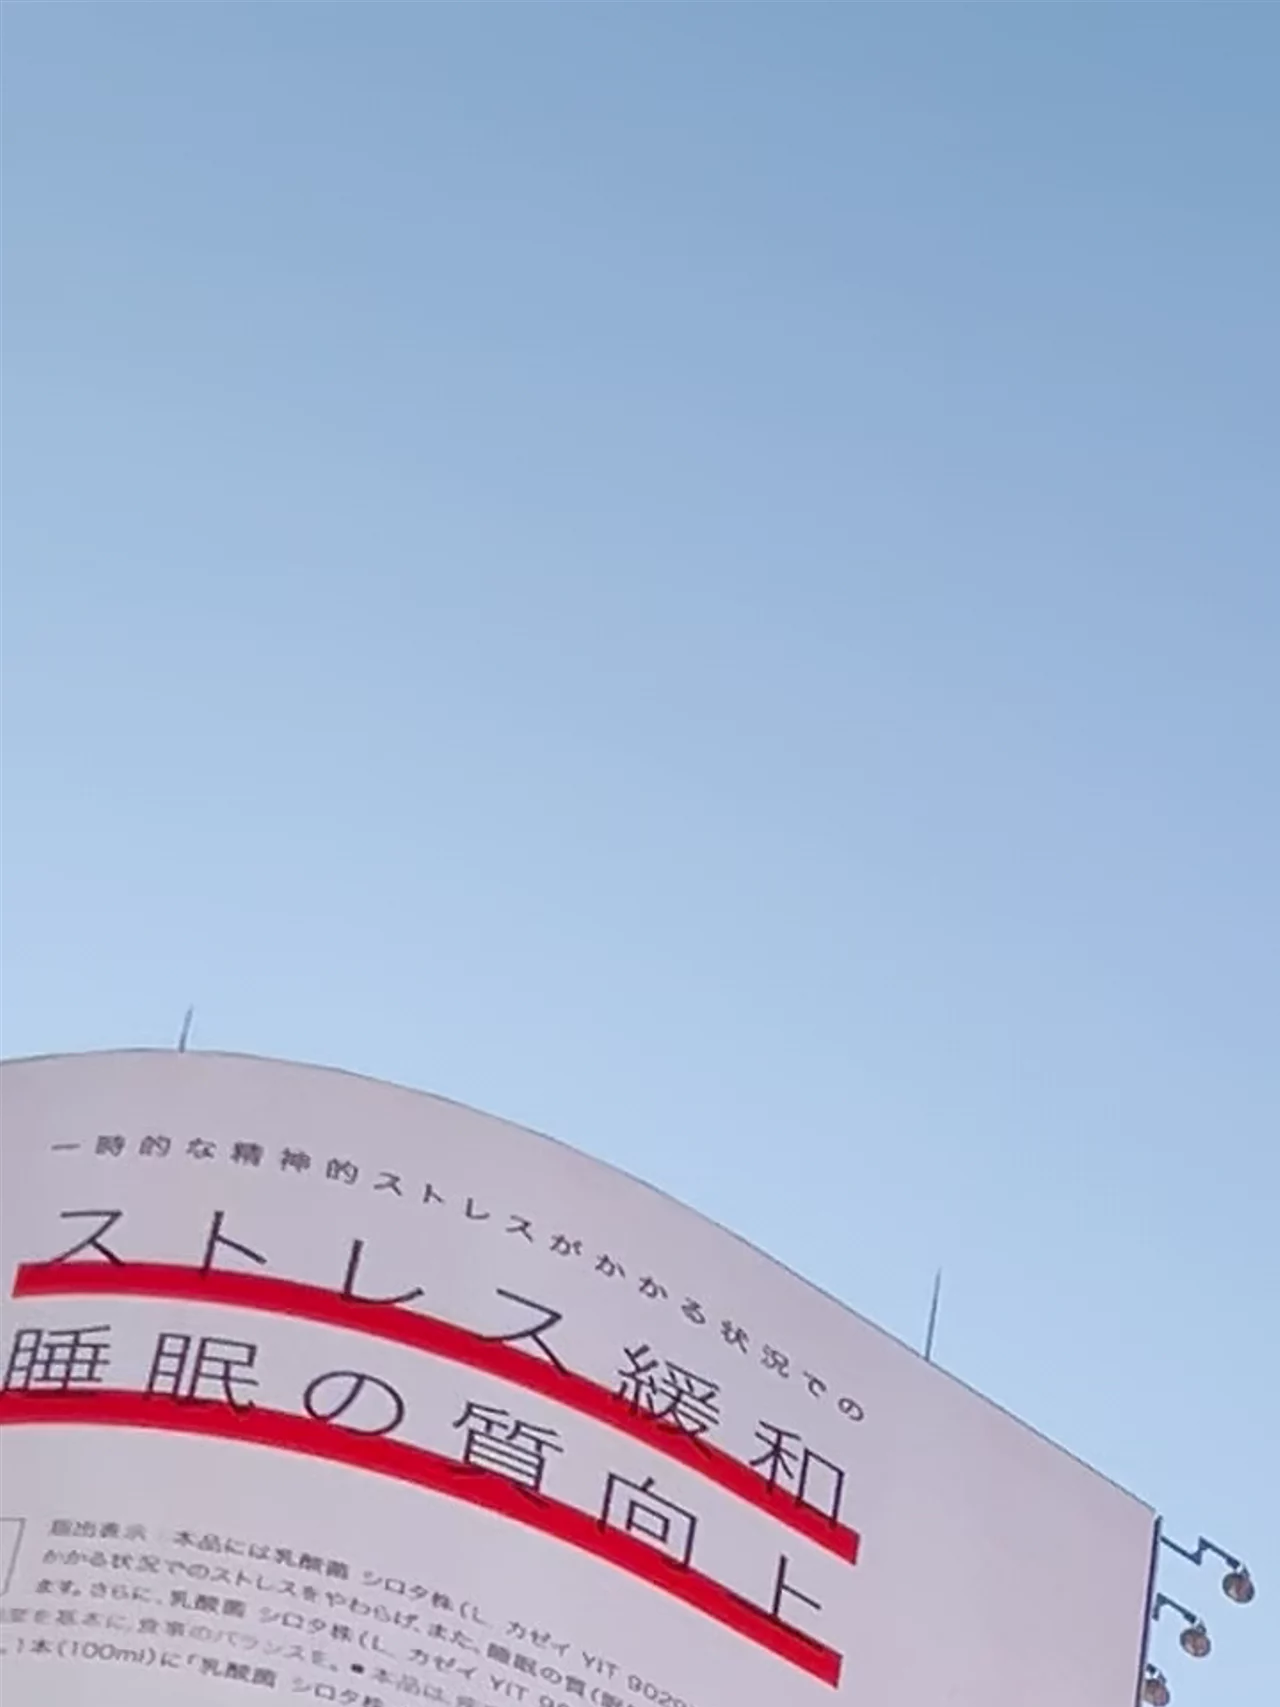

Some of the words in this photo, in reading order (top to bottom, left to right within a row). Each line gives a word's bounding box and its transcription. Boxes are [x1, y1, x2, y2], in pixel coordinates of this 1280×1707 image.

[51, 1134, 865, 1422] 一時的な精神的ストレスがかかる状況での
[57, 1208, 846, 1530] ストレス緩和
[2, 1324, 824, 1652] 睡眠の質向上
